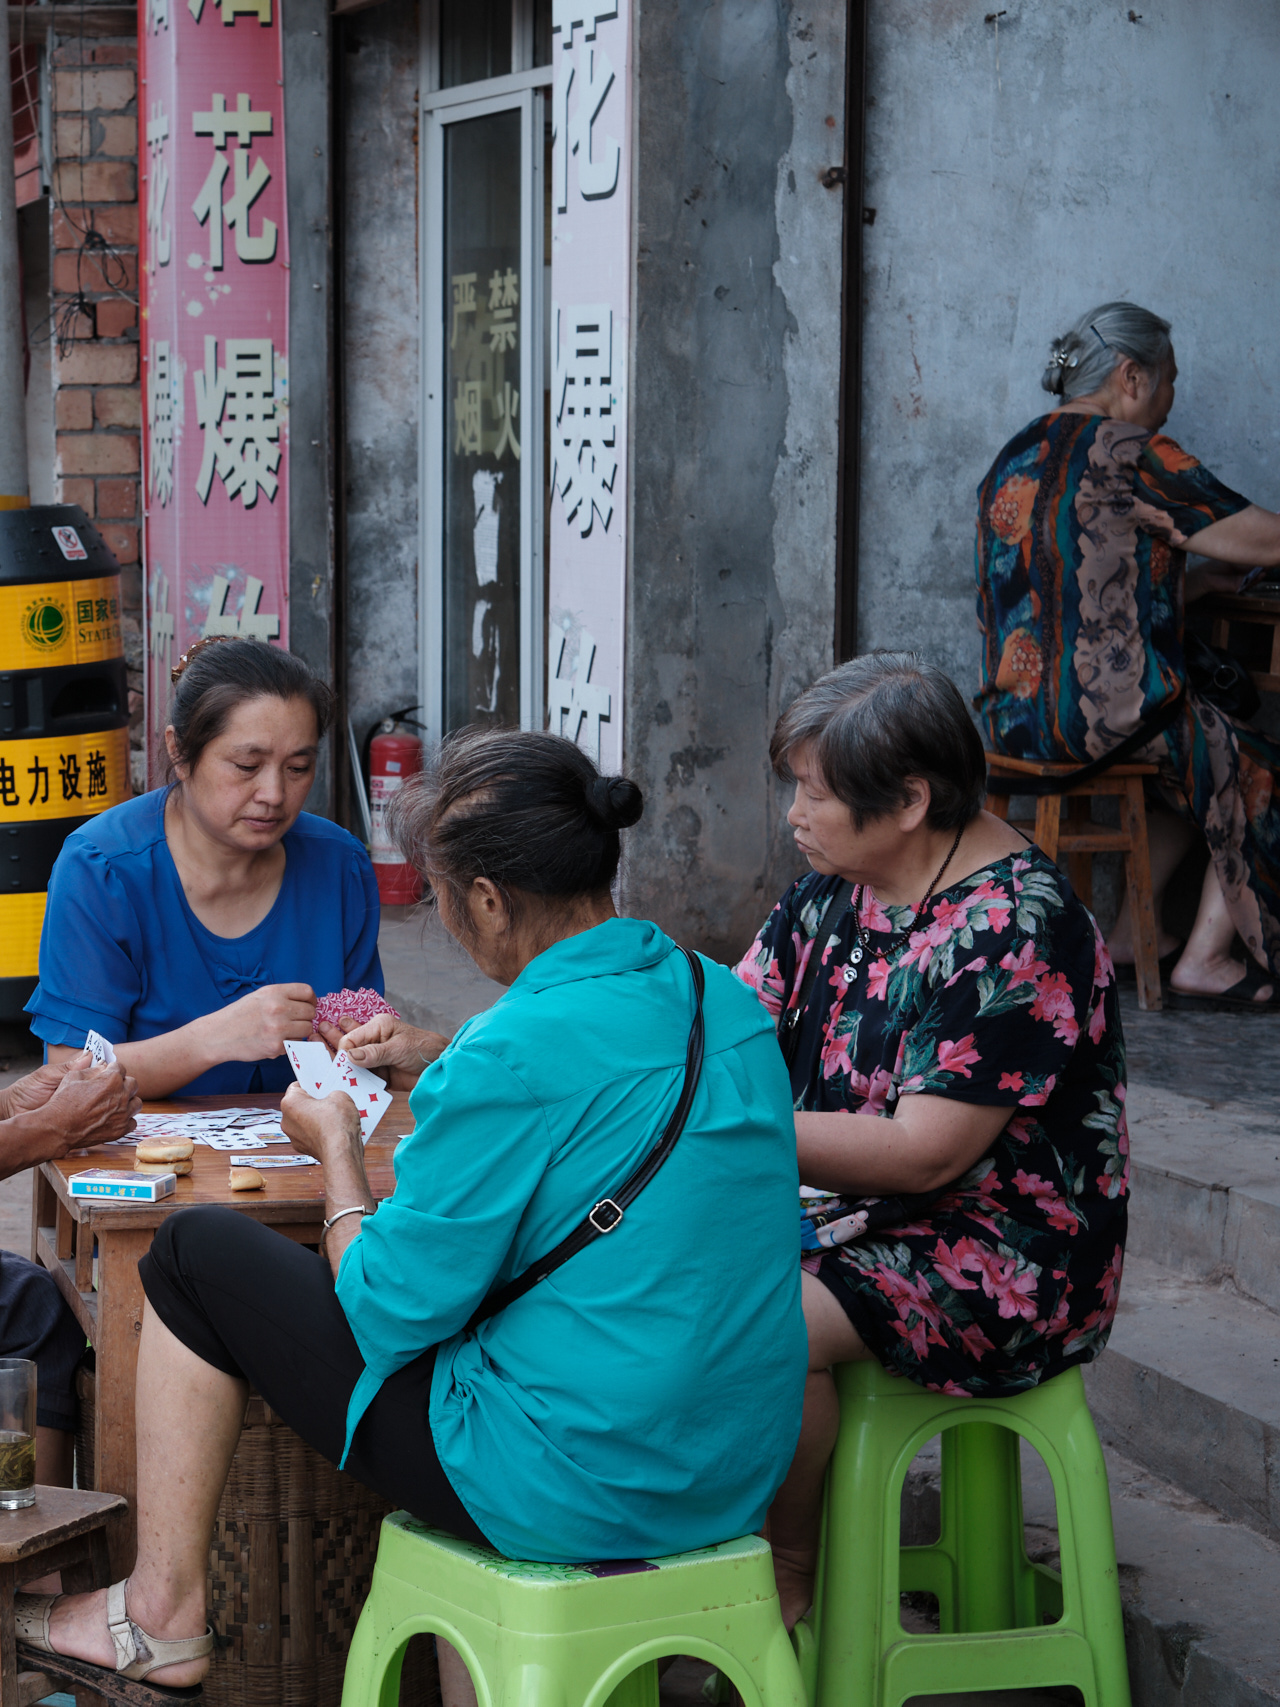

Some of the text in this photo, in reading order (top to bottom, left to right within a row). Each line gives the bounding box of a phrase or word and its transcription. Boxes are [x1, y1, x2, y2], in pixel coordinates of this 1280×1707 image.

[79, 628, 111, 643] STATE
[338, 1053, 347, 1063] 5
[345, 1066, 353, 1075] 7
